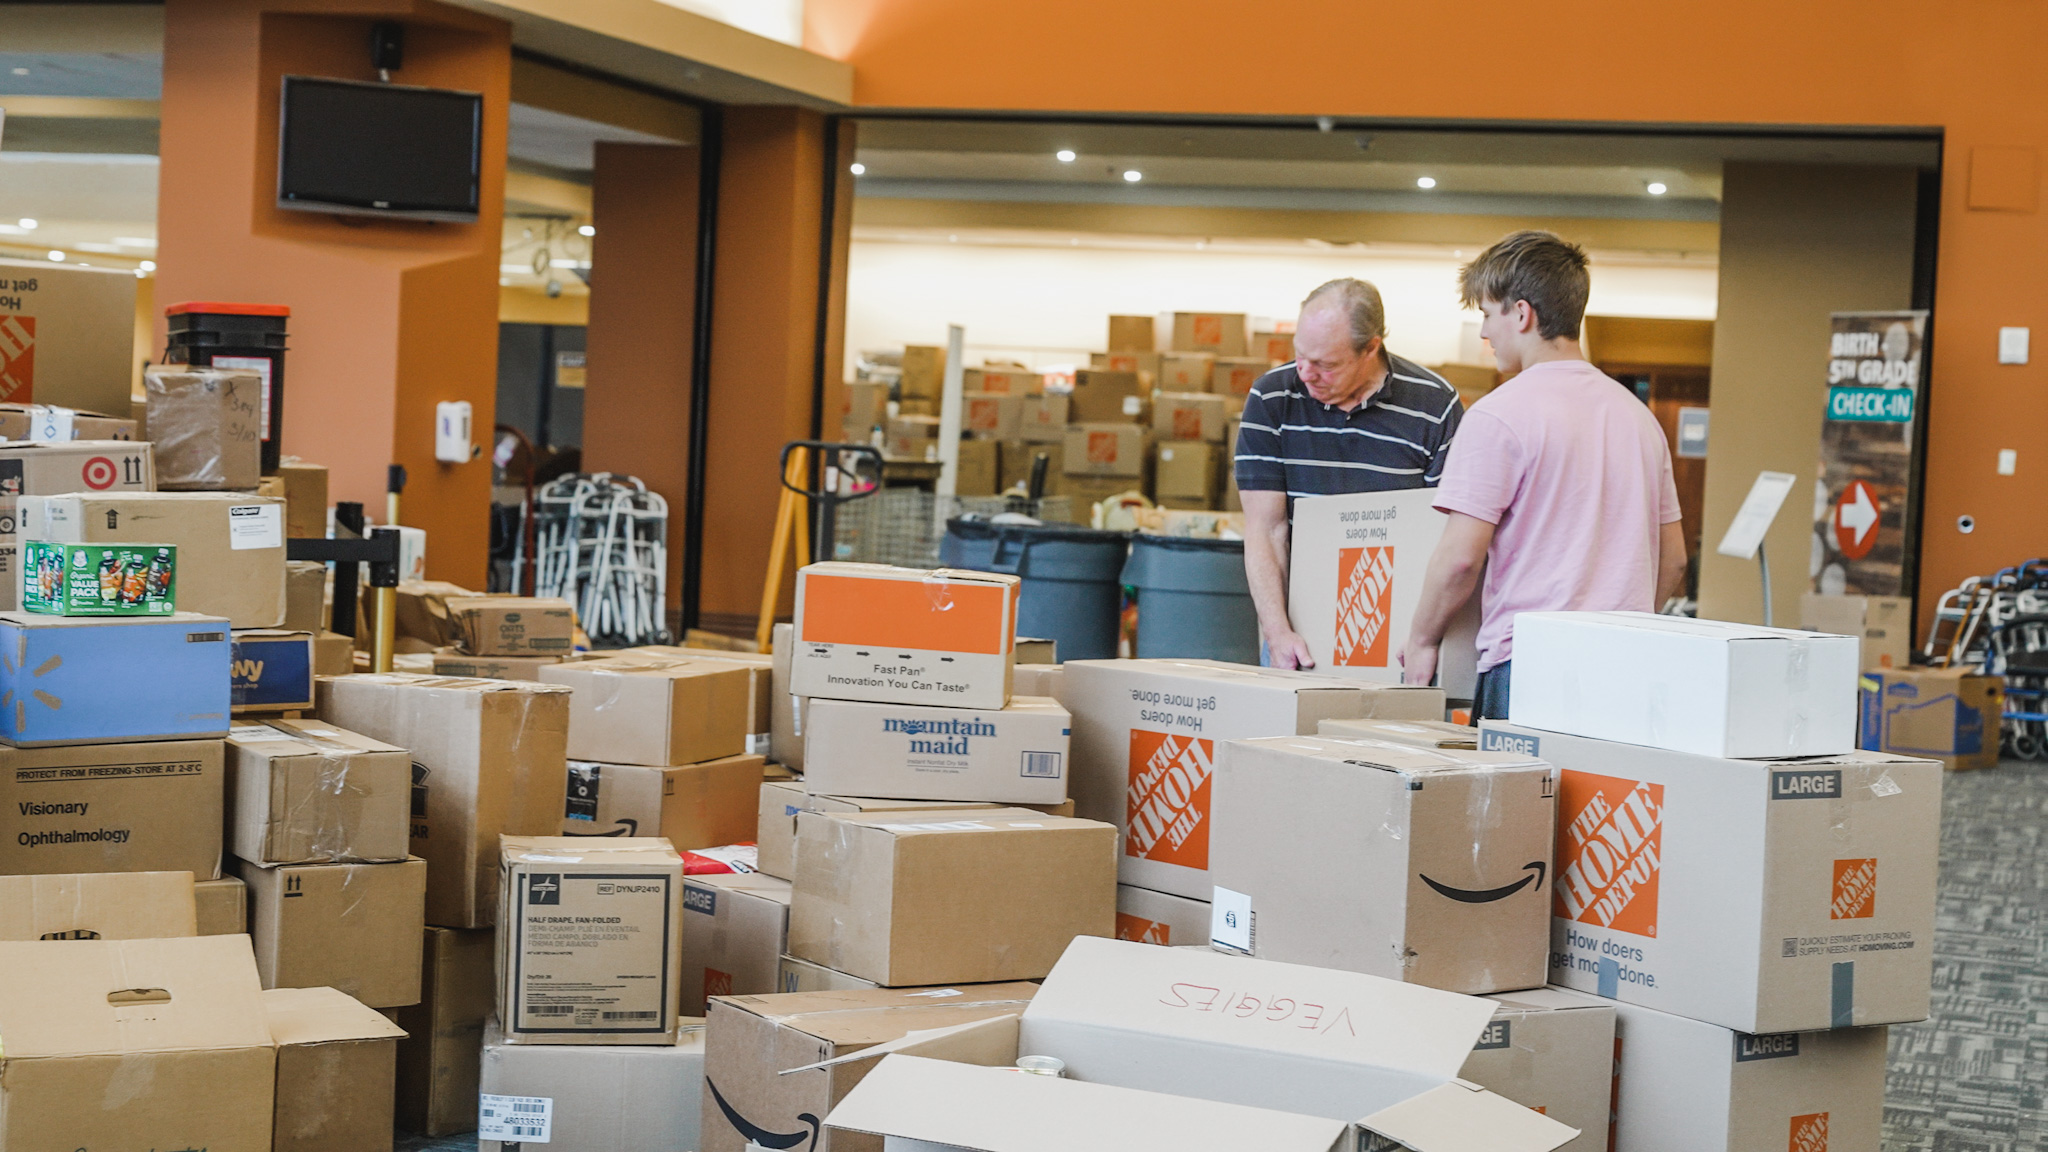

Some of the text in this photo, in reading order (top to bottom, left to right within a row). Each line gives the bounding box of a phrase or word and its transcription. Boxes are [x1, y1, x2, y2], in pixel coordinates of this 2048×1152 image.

[13, 278, 38, 292] get
[0, 296, 21, 310] Ho
[1831, 332, 1879, 357] BIRTH
[1858, 359, 1915, 385] GRADE
[1832, 392, 1911, 417] CHECK-IN
[1361, 510, 1381, 521] more
[1383, 506, 1397, 519] get
[1346, 527, 1388, 541] How doers
[70, 580, 99, 588] VALUE
[70, 588, 99, 597] PACK
[1336, 547, 1372, 622] DEPOT
[1334, 547, 1394, 666] HOME
[500, 624, 525, 632] OATS
[1360, 607, 1386, 654] THE
[873, 664, 897, 675] Fast
[827, 674, 884, 687] Innovation
[887, 679, 908, 689] You
[911, 680, 932, 690] Can
[1164, 693, 1194, 708] more
[1197, 696, 1216, 711] get
[1140, 709, 1203, 732] How doers
[909, 736, 970, 756] maid
[1486, 734, 1533, 755] LARGE
[16, 770, 58, 780] PROTECT
[60, 769, 86, 777] FROM
[88, 765, 163, 776] FREEZING-STORE
[165, 764, 175, 773] AT
[1127, 734, 1181, 810] DEPOT
[1778, 775, 1836, 794] LARGE
[18, 801, 89, 816] Visionary
[1125, 738, 1214, 859] HOME
[1166, 802, 1203, 851] THE
[1567, 790, 1612, 847] THE
[17, 827, 131, 848] Ophthalmology
[1556, 781, 1663, 921] HOME
[1593, 840, 1661, 928] DEPOT
[1836, 865, 1856, 889] THE
[1831, 858, 1877, 919] HOME
[1848, 879, 1877, 918] DEPOT
[683, 889, 713, 910] ARGE
[1566, 928, 1643, 962] How doers
[1799, 931, 1912, 946] QUICKLY ESTIMATE YOUR PACKING
[1799, 947, 1825, 956] SUPPLY
[1827, 945, 1849, 954] NEEDS
[1850, 944, 1859, 952] AT
[1552, 951, 1575, 969] get
[1578, 957, 1600, 974] mo
[1159, 982, 1356, 1037] VEGGIES
[1742, 1034, 1793, 1056] LARGE
